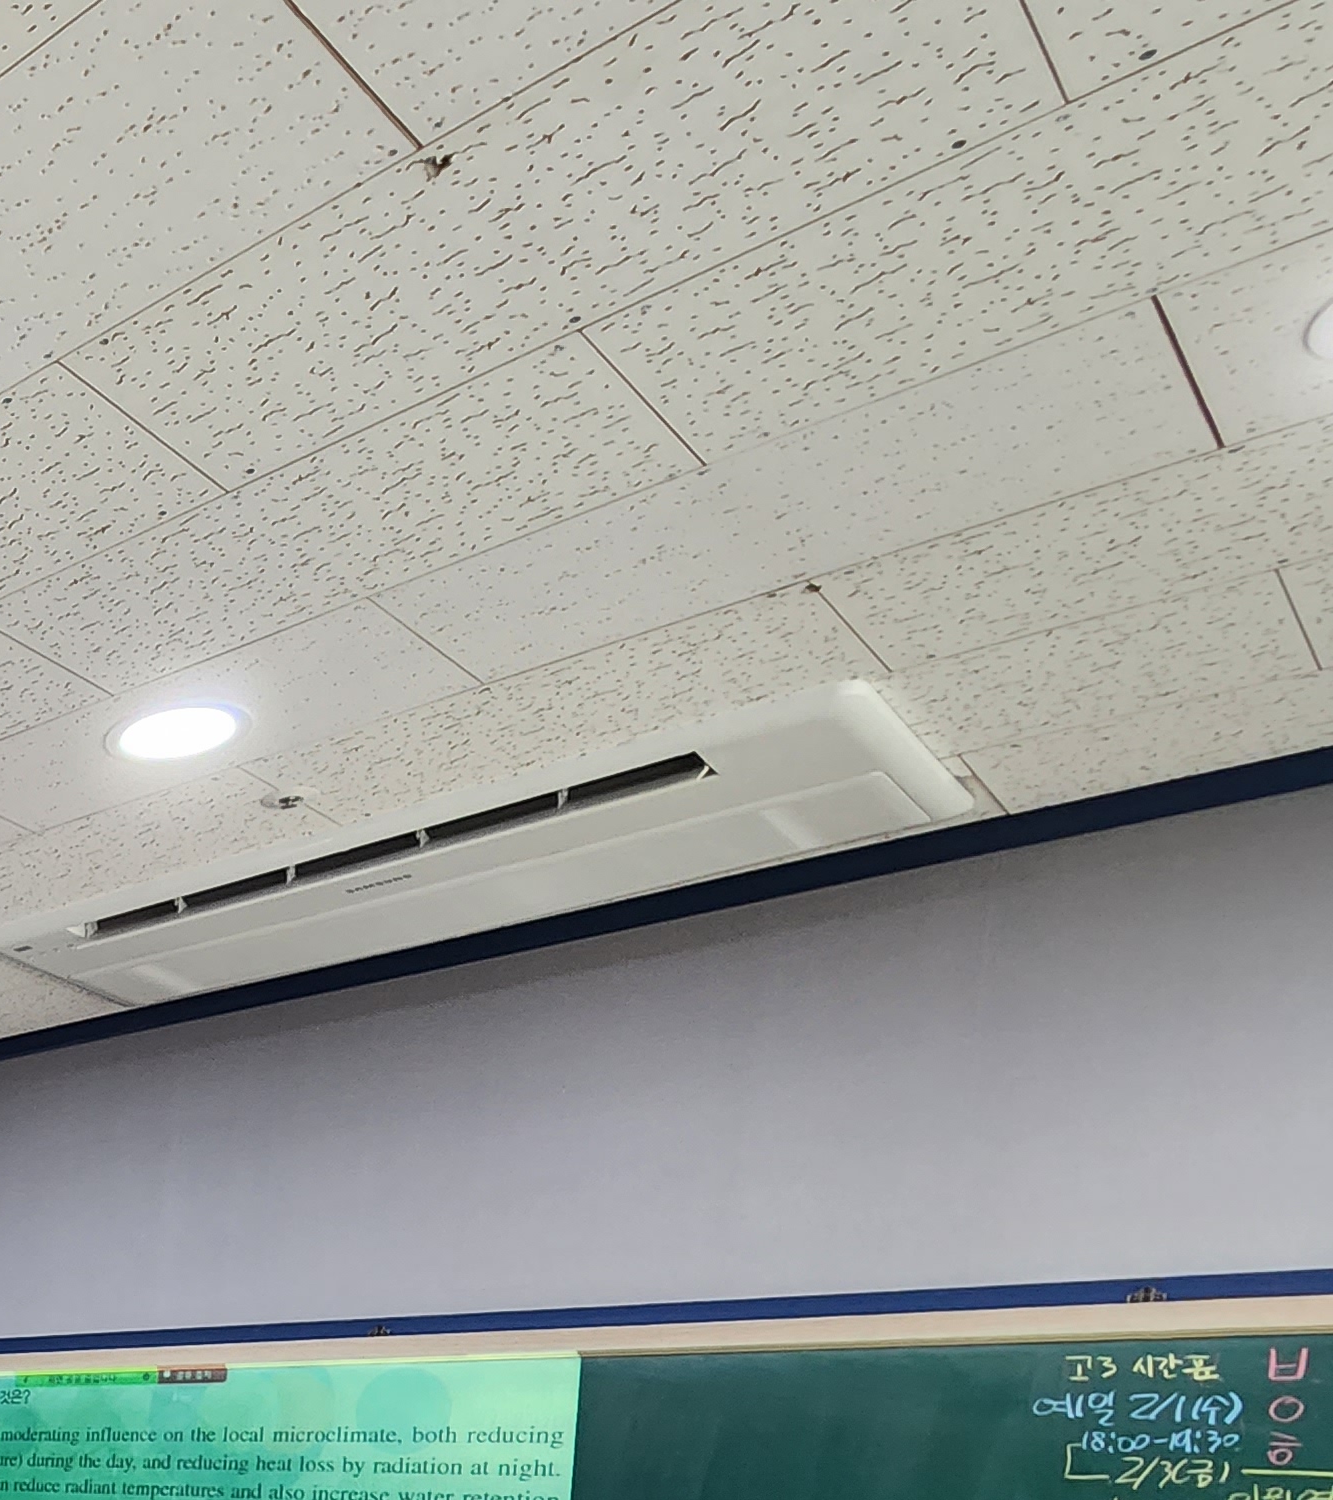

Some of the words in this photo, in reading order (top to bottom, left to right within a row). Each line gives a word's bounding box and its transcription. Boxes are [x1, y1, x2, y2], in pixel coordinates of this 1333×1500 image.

[0, 1389, 31, 1404] 것은?
[1, 1428, 79, 1445] moderating
[86, 1427, 157, 1442] influence
[163, 1431, 183, 1442] on
[191, 1427, 215, 1442] the
[223, 1427, 264, 1442] local
[273, 1426, 403, 1444] microclimate,
[412, 1426, 457, 1443] both
[467, 1426, 564, 1448] reducing
[27, 1453, 73, 1471] during
[79, 1453, 101, 1468] the
[106, 1454, 136, 1473] day,
[143, 1455, 171, 1469] and
[177, 1456, 249, 1474] reducing
[256, 1456, 292, 1472] heat
[300, 1457, 334, 1472] loss
[343, 1457, 365, 1477] by
[373, 1457, 462, 1475] radiation
[470, 1461, 489, 1475] at
[498, 1459, 561, 1481] night.
[14, 1478, 59, 1493] reduce
[65, 1479, 116, 1494] radiant
[122, 1483, 224, 1500] temperatures
[231, 1484, 262, 1500] and
[269, 1484, 305, 1500] also
